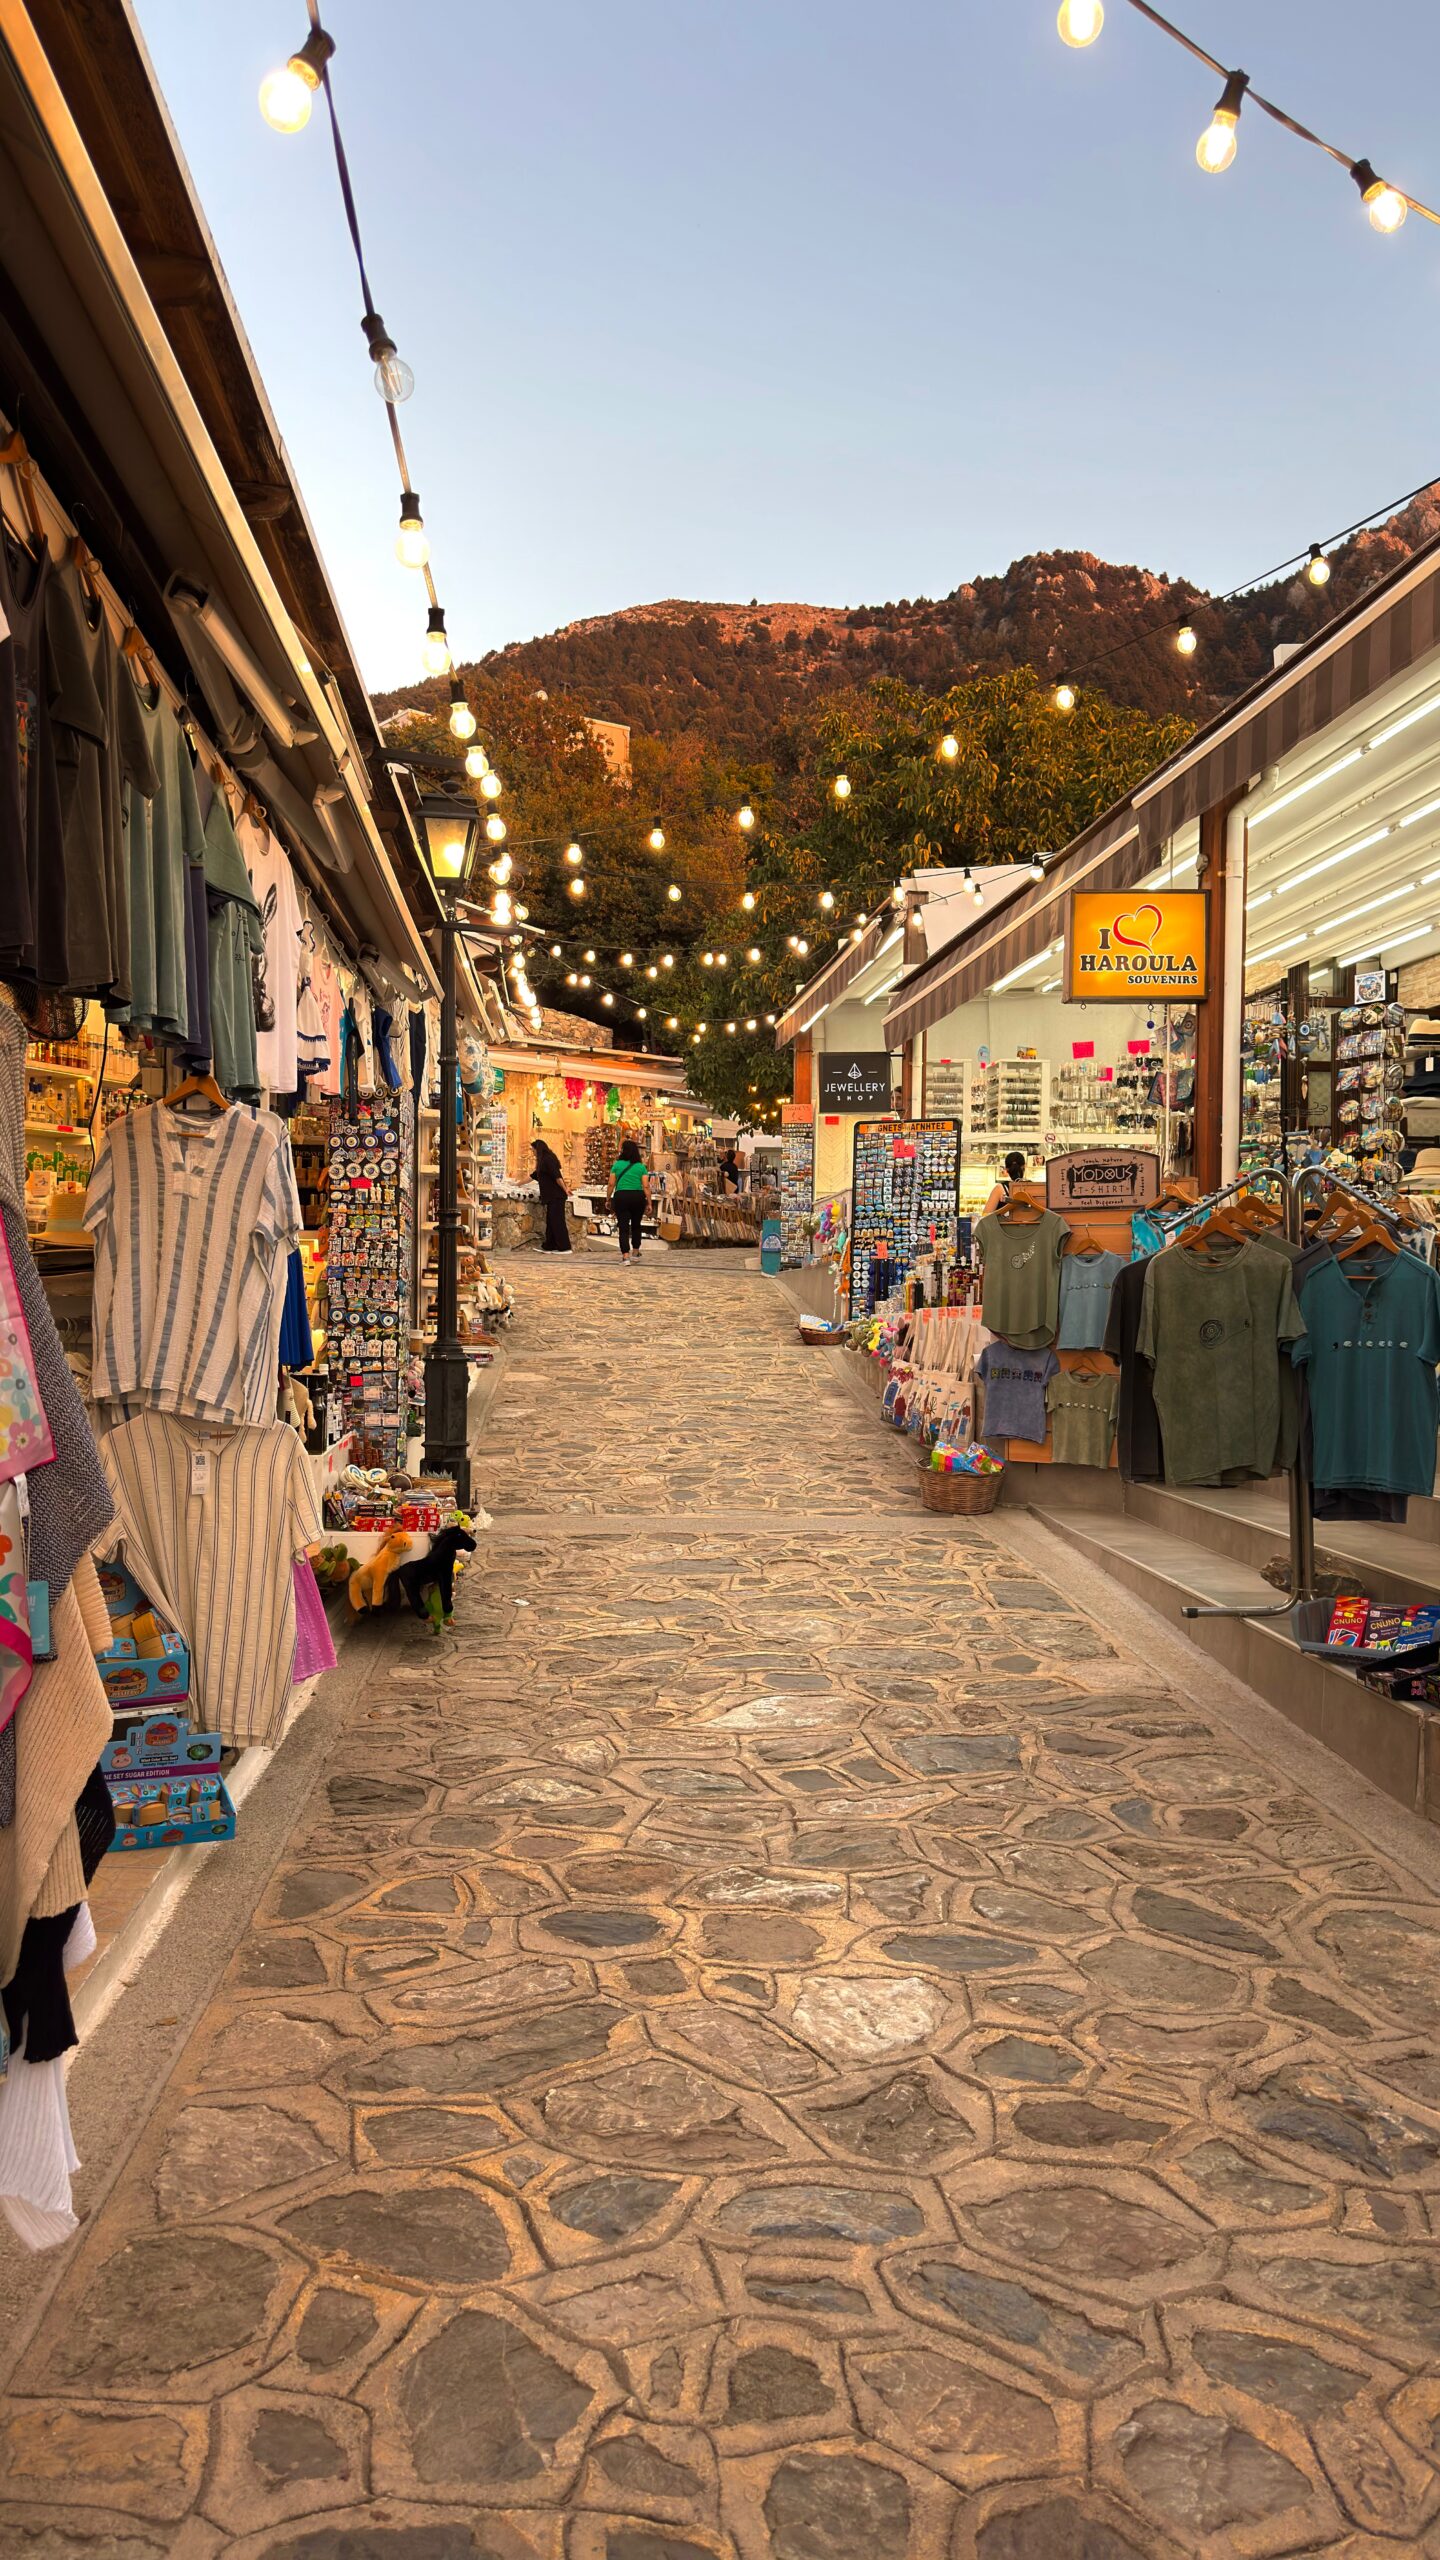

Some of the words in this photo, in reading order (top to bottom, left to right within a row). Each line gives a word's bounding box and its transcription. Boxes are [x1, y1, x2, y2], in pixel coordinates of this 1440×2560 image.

[1099, 928, 1110, 950] I
[1080, 955, 1197, 971] HAROULA
[1127, 975, 1198, 984] SOUVENIRS
[824, 1082, 886, 1093] JEWELLERY
[1333, 1617, 1363, 1625] CNUNO
[1370, 1617, 1401, 1630] CNUNO
[113, 1772, 125, 1780] SET
[125, 1771, 145, 1779] SUGAR
[146, 1769, 170, 1777] EDITION
